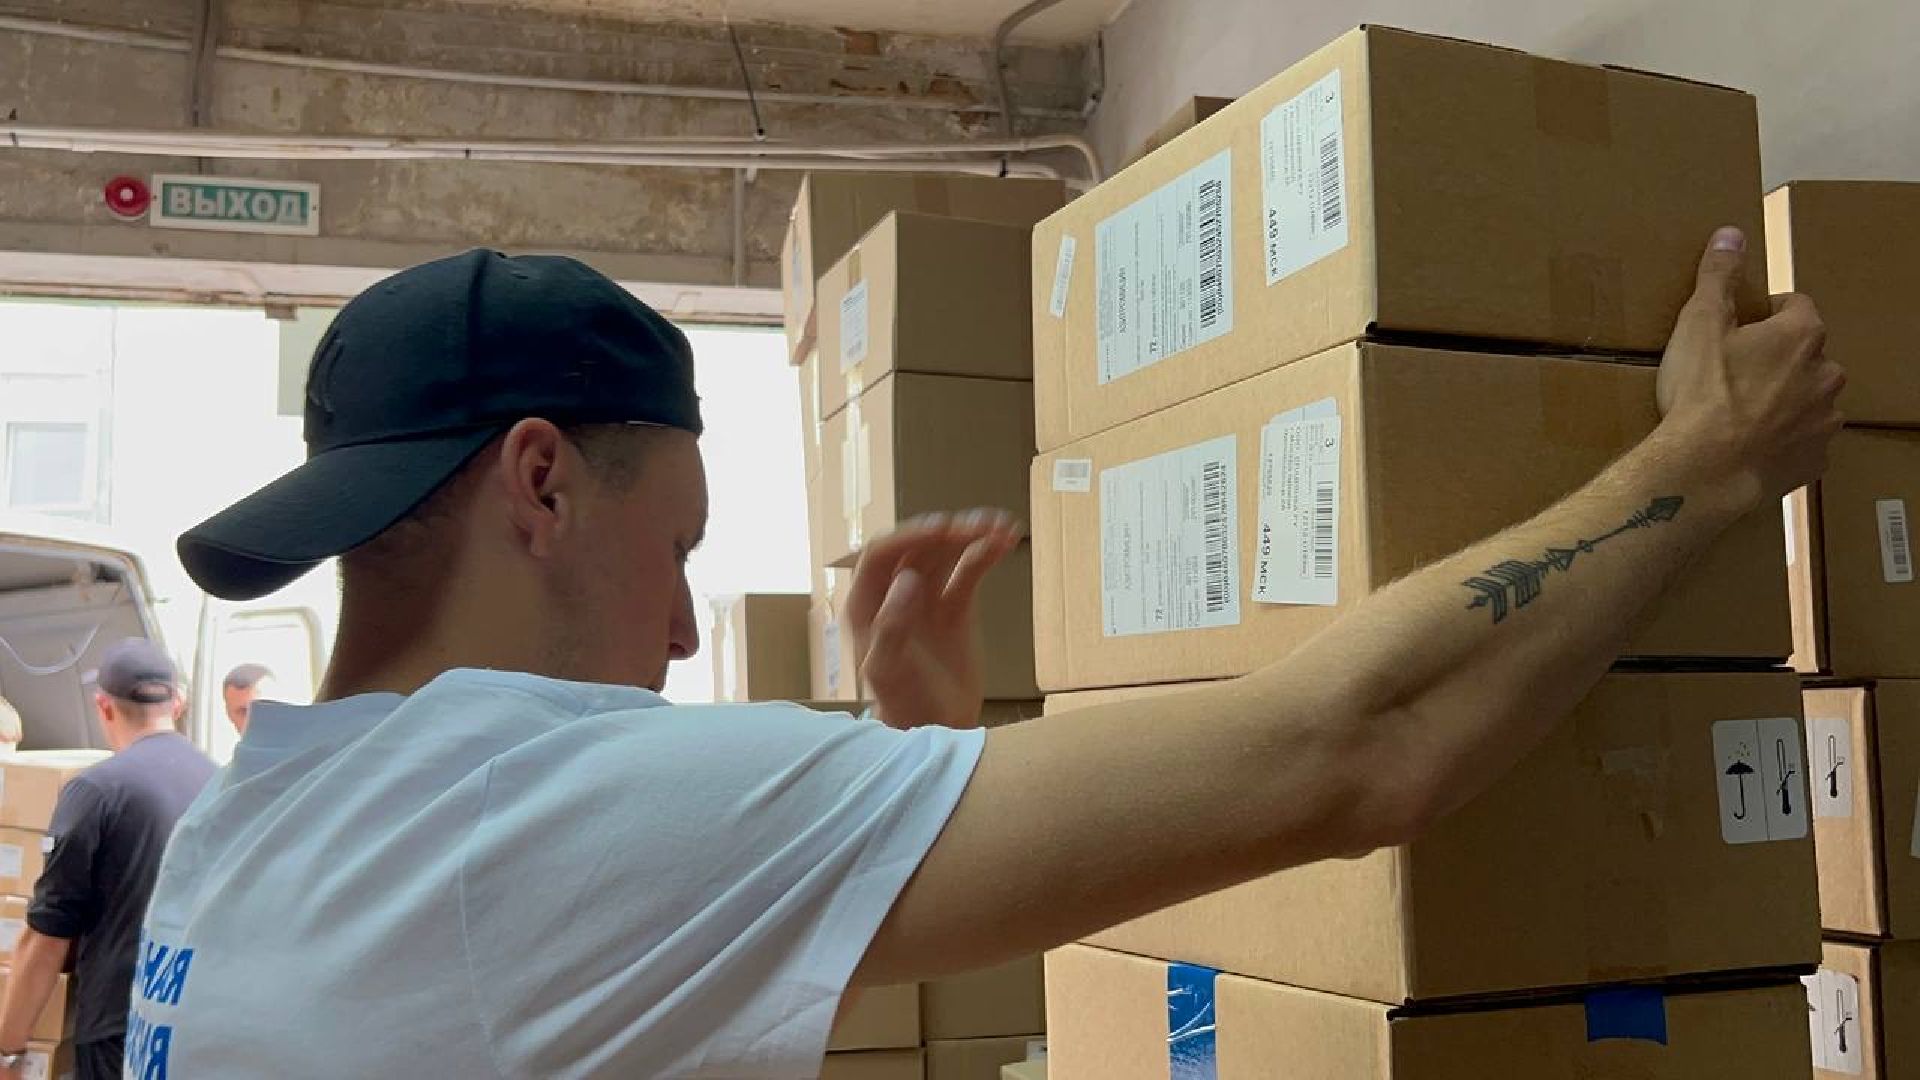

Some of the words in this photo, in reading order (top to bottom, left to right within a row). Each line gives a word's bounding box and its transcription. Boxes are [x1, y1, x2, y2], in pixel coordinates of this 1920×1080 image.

[170, 186, 302, 225] ВЫХОД
[1325, 437, 1335, 448] 3
[1260, 523, 1271, 556] 449
